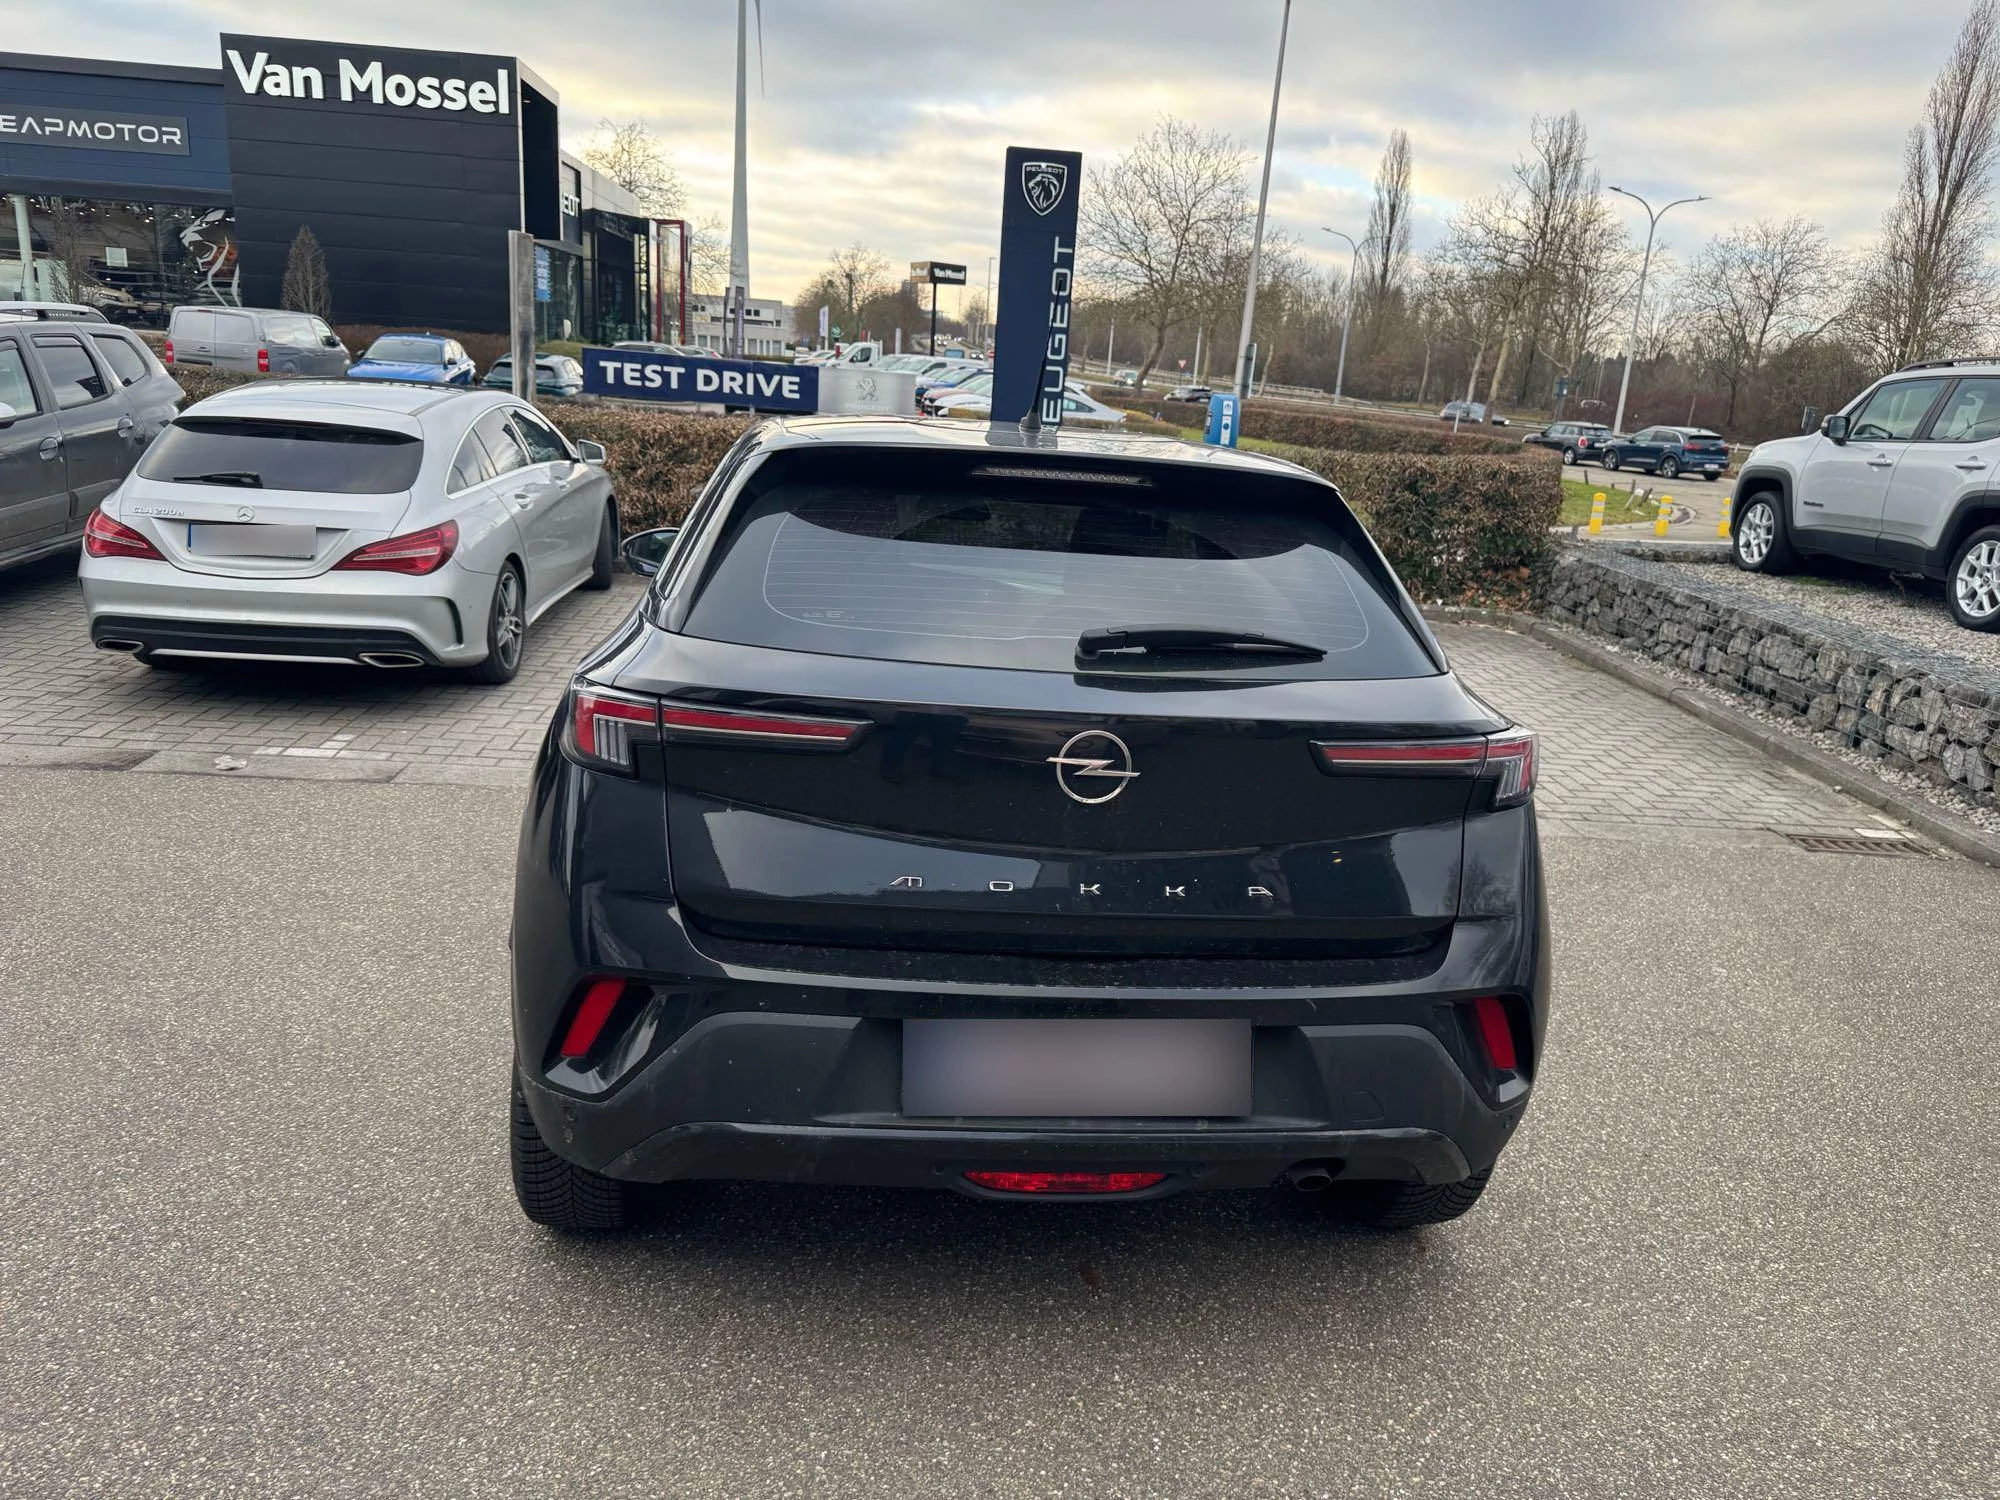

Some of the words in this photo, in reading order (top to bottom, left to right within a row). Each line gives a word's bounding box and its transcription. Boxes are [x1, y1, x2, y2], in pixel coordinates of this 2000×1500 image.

[226, 49, 325, 100] Van
[339, 58, 510, 114] Mossel
[0, 114, 182, 145] EAPMOTOR
[1026, 166, 1063, 174] PEUGEOT
[1041, 236, 1073, 423] EUGEOT
[599, 361, 685, 389] TEST
[696, 370, 801, 400] DRIVE
[132, 506, 153, 514] CLA
[889, 876, 1274, 898] MOKKA
